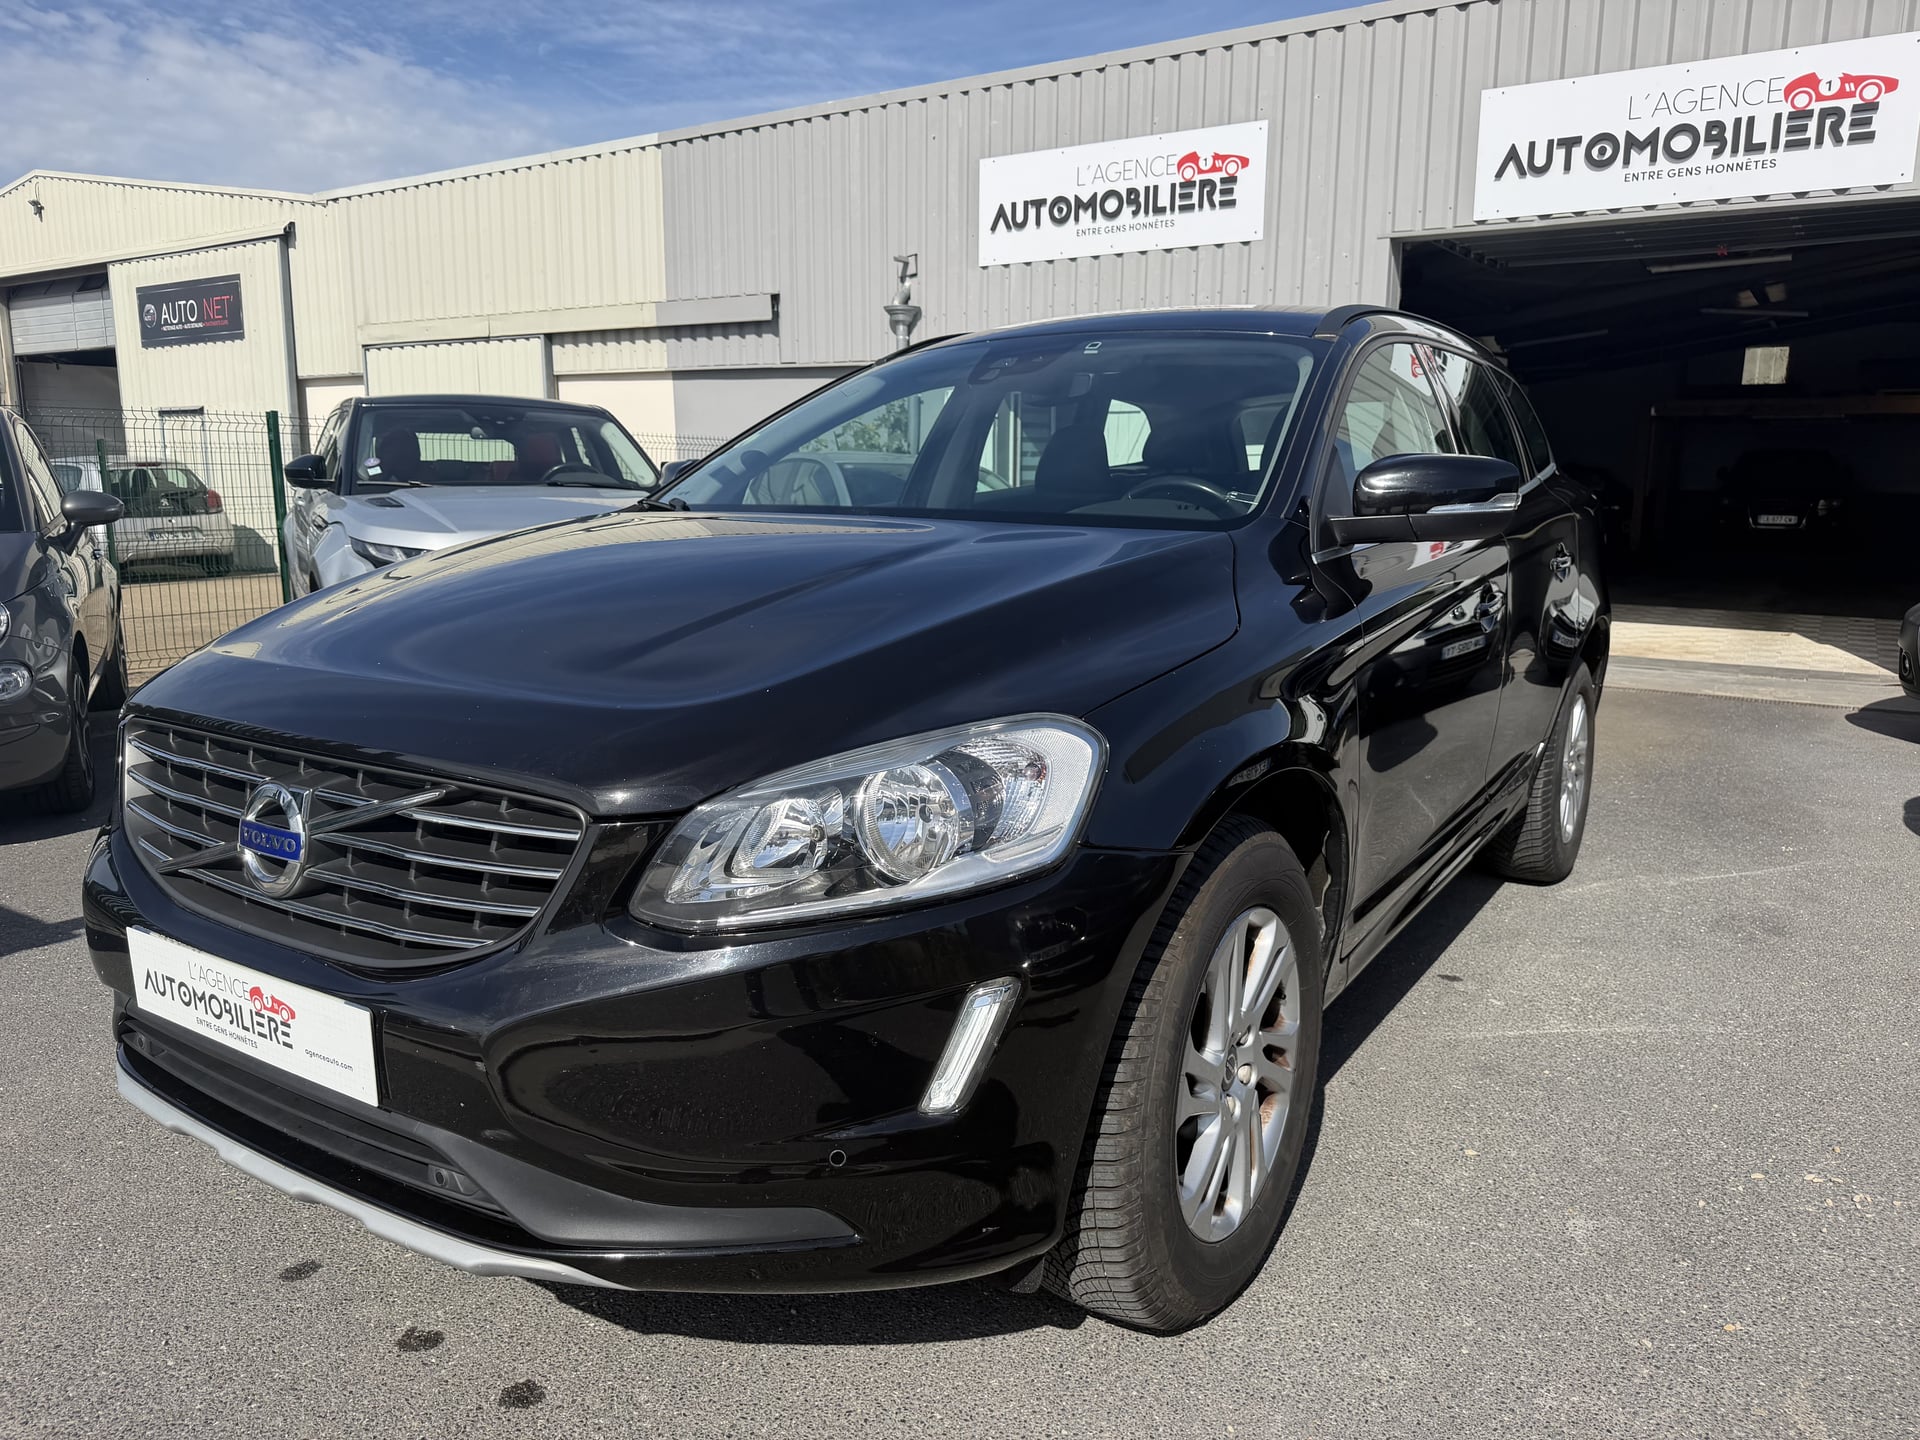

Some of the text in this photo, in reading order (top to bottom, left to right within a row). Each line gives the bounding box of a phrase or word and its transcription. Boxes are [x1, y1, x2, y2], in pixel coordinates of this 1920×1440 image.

[1627, 75, 1786, 121] L'AGENCE
[1824, 79, 1834, 93] 1
[1076, 154, 1178, 187] L'AGENCE
[1623, 157, 1778, 183] ENTRE GENS HONNÊTES
[1076, 218, 1176, 237] ENTRE GENS HONNÊTES
[161, 299, 198, 325] AUTO
[241, 826, 297, 853] VOLVO
[187, 961, 250, 1001] L'AGENCE
[196, 1016, 258, 1049] ENTRE GENS HONNÊTES
[304, 1048, 354, 1072] agenceauto.com
